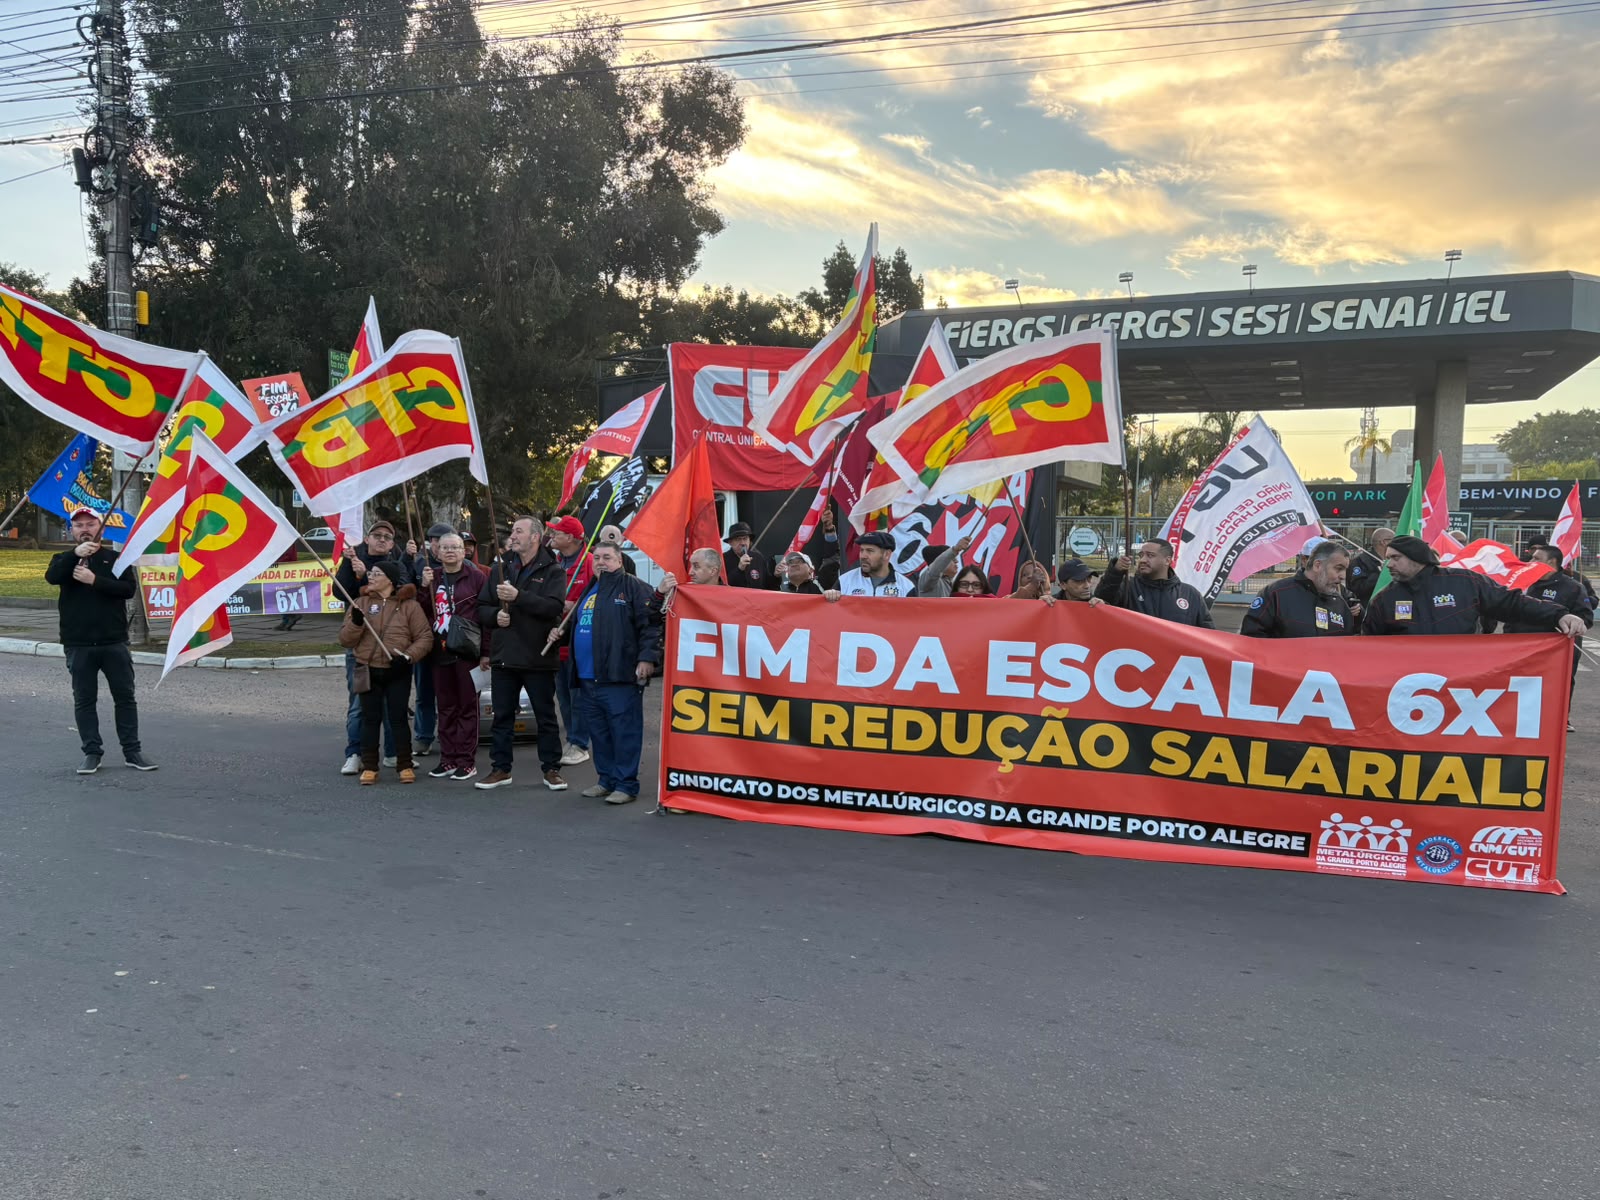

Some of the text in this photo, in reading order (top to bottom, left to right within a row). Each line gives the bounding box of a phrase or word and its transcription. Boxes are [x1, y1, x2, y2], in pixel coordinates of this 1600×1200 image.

[261, 381, 288, 395] FIM
[265, 392, 299, 405] ESCALA
[693, 365, 791, 428] CU
[693, 429, 736, 446] CNTRAL
[1344, 490, 1387, 500] PARK
[1460, 487, 1562, 499] BEM-VINDO
[141, 572, 169, 582] PELA
[284, 569, 297, 579] DE
[148, 586, 175, 608] 40
[276, 586, 309, 613] 6x1
[677, 618, 1543, 739] FIM DA ESCALA 6x1
[672, 689, 1546, 808] SEM REDUÇÃO SALARIAL!
[669, 772, 1306, 851] SINDICATO DOS METALÚRGICOS DA GRANDE PORTO ALEGRE
[1317, 848, 1407, 862] METALÚRGICOS
[1327, 857, 1354, 865] GRANDE
[1356, 859, 1378, 867] PORTO
[1380, 861, 1407, 870] ALEGRE
[1467, 859, 1531, 881] CUT
